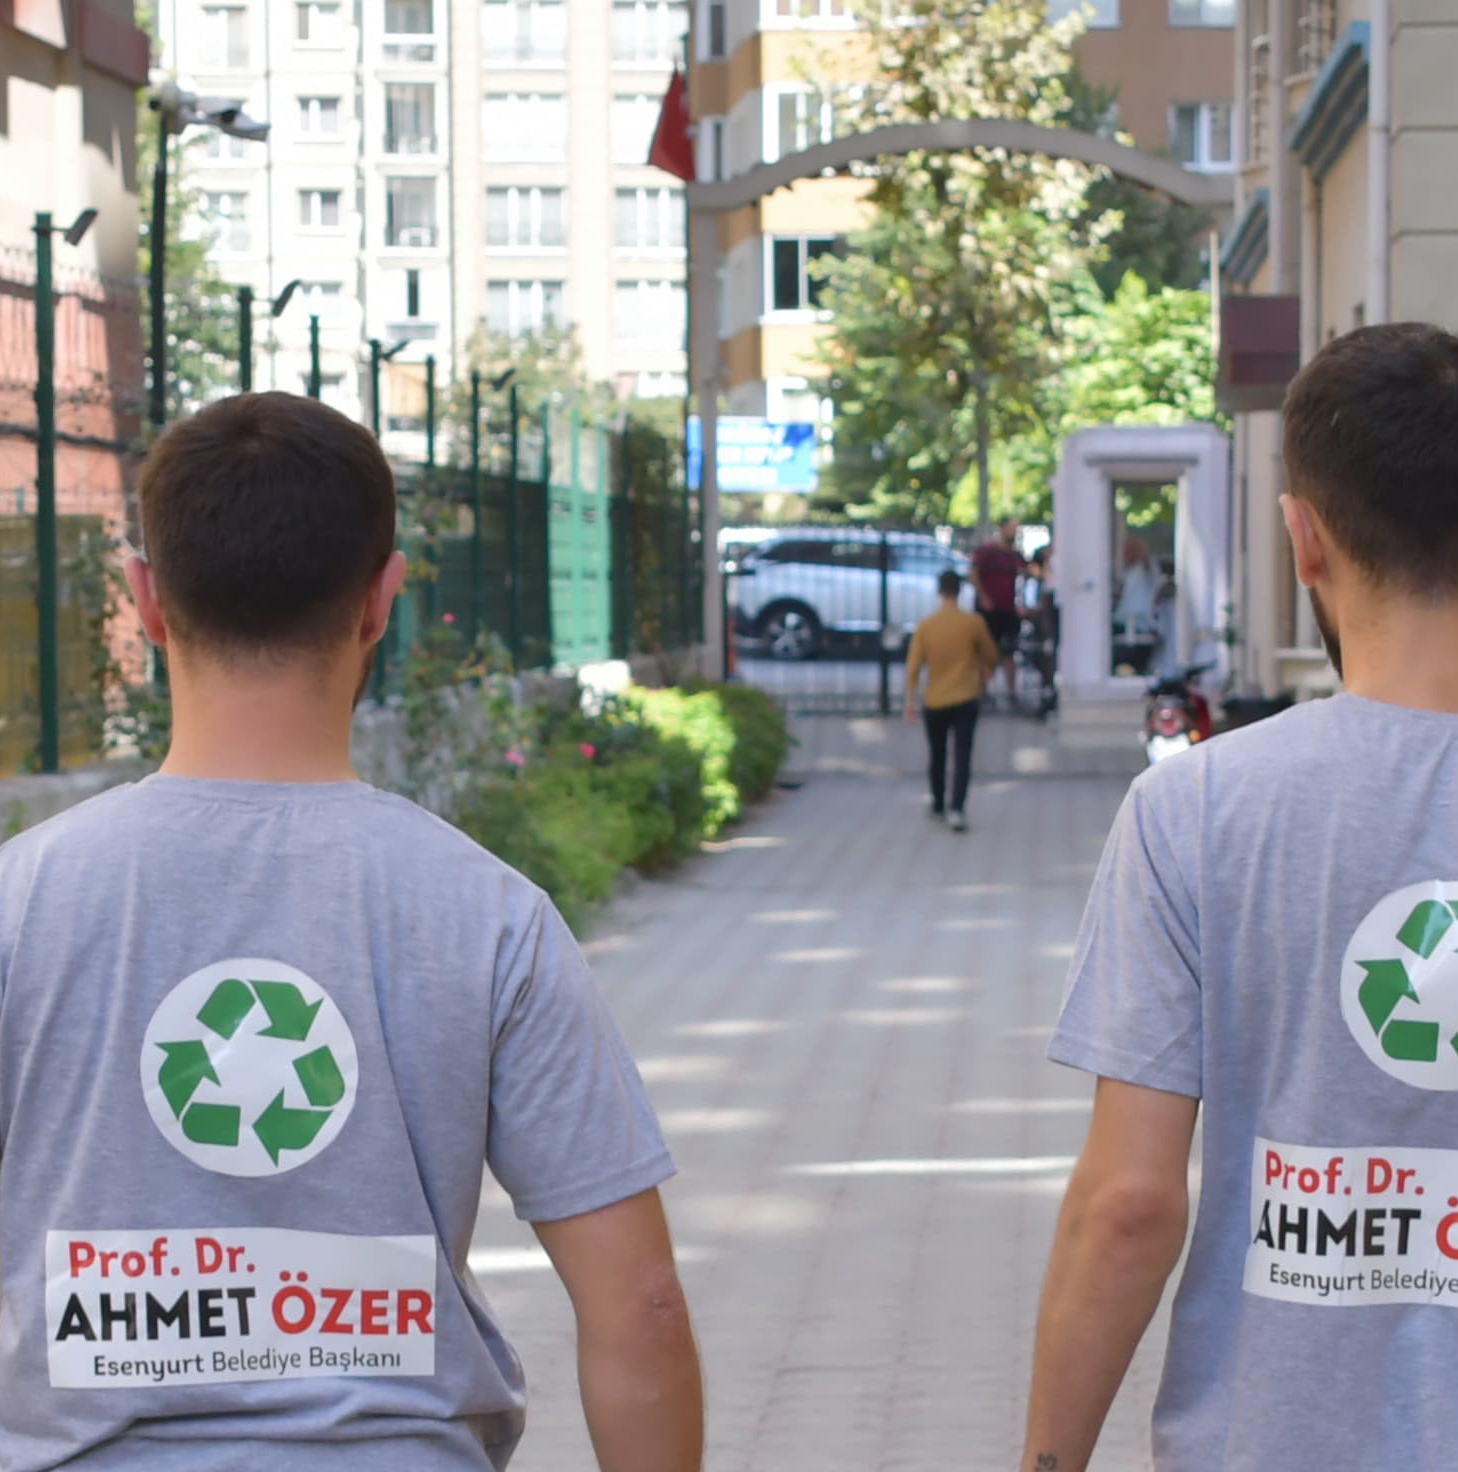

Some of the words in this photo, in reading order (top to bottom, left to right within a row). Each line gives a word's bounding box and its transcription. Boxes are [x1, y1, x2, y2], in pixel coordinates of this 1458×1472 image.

[1265, 1149, 1352, 1196] Prof.
[1366, 1157, 1425, 1196] Dr.
[1253, 1198, 1422, 1257] AHMET
[68, 1236, 181, 1278] Prof.
[194, 1236, 256, 1274] Dr.
[1269, 1263, 1365, 1296] Esenyurt
[55, 1286, 257, 1342] AHMET
[271, 1270, 435, 1336] ÖZER
[93, 1353, 205, 1382] Esenyurt
[211, 1347, 302, 1375] Belediye
[308, 1346, 401, 1372] Başkanı
